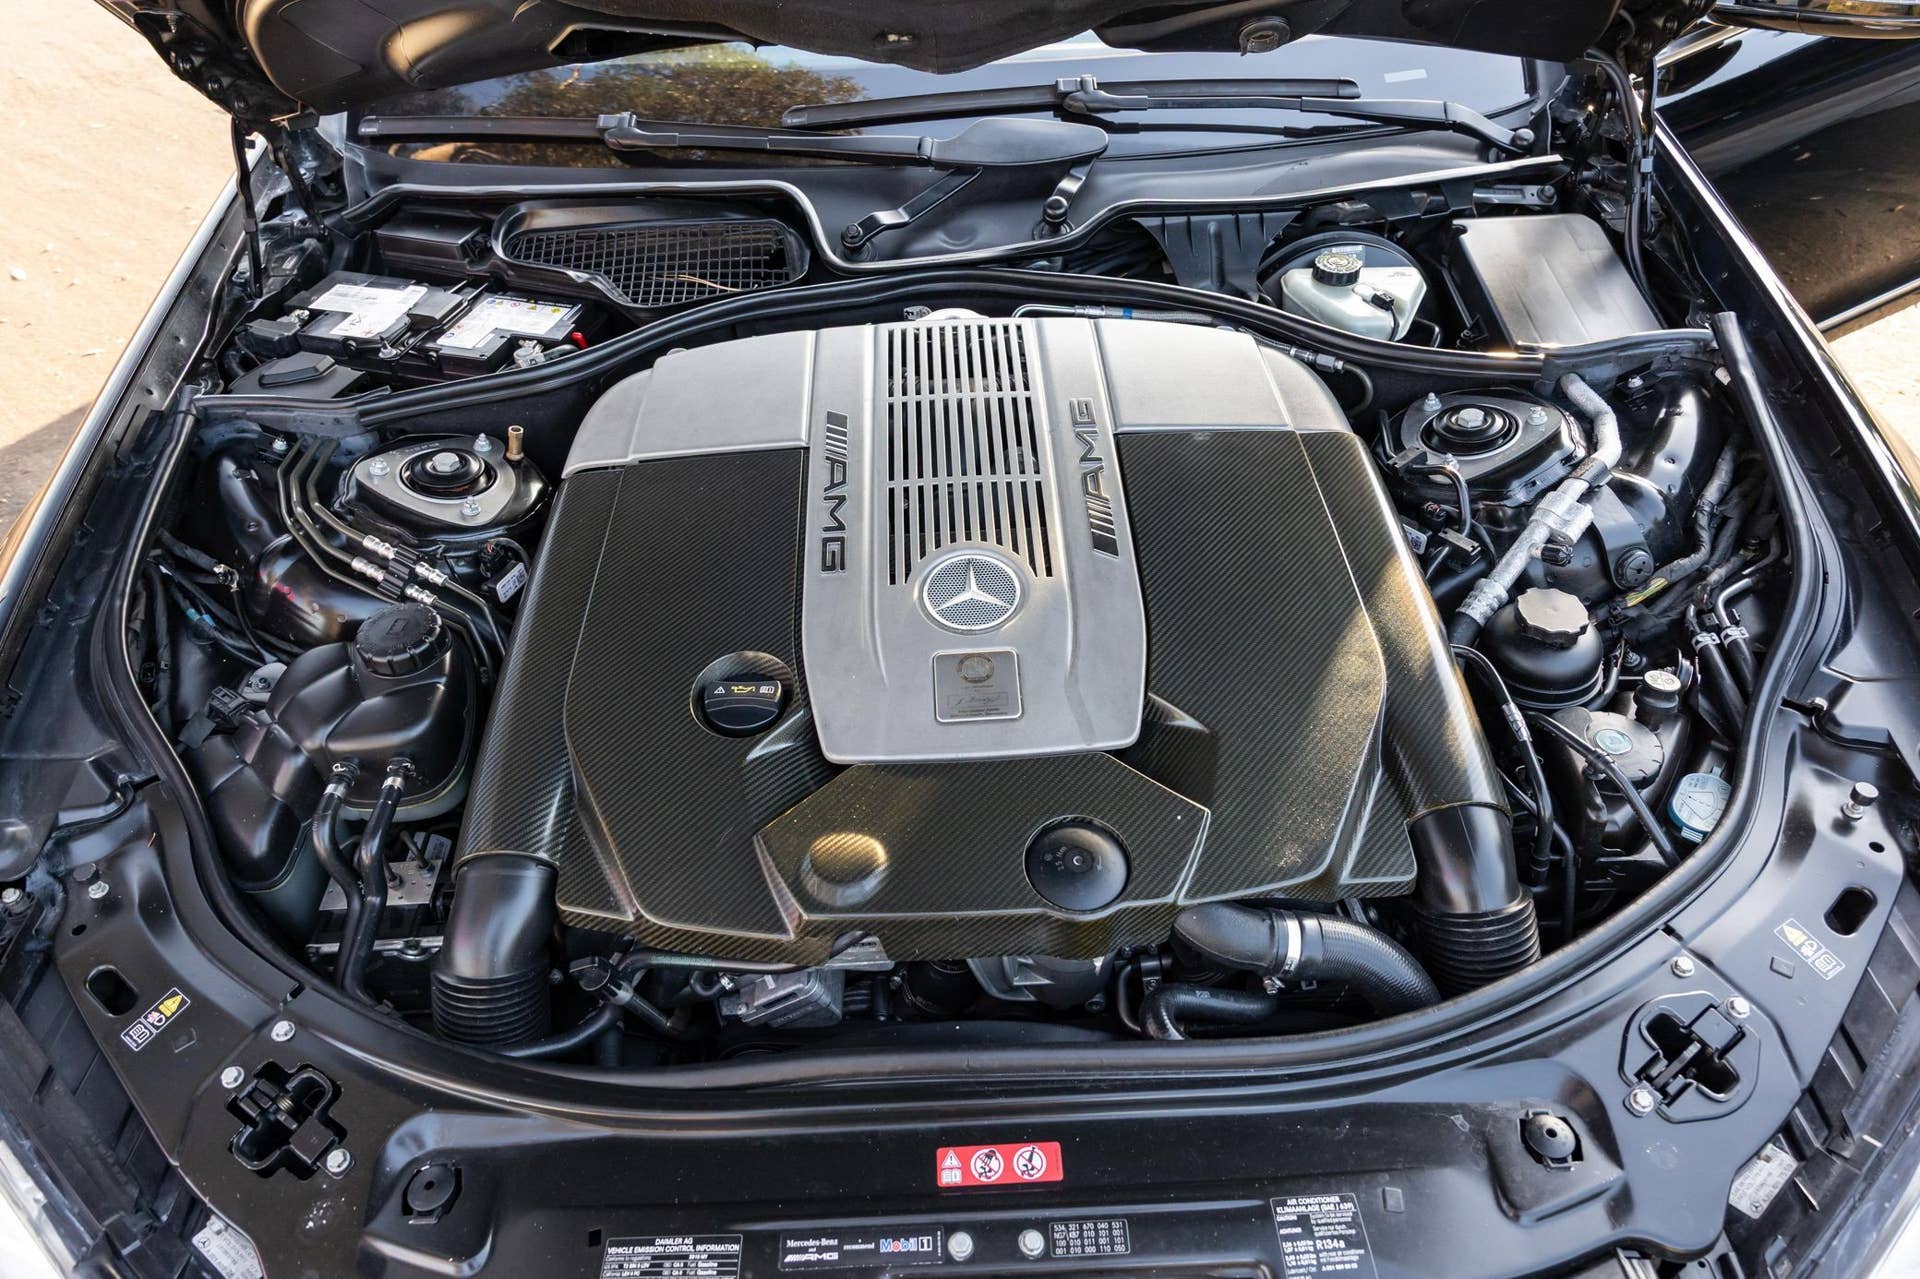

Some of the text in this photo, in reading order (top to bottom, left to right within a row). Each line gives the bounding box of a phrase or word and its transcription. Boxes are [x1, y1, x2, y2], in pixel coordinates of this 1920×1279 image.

[1069, 397, 1111, 502] AMG
[821, 455, 848, 572] AMG
[1298, 1195, 1340, 1205] CONDITIONER
[1111, 1221, 1123, 1229] 531
[1098, 1229, 1109, 1237] 101
[655, 1237, 694, 1246] DAIMLER AG
[786, 1237, 839, 1249] Mercedes-Benz
[879, 1236, 917, 1252] Mobil
[1055, 1239, 1067, 1247] 100
[1084, 1238, 1095, 1246] 011
[1099, 1237, 1110, 1245] 001
[1114, 1236, 1124, 1244] 101
[1316, 1239, 1346, 1250] R134a
[634, 1246, 665, 1254] EMISSION
[665, 1245, 695, 1253] CONTROL
[1055, 1247, 1067, 1255] 001
[1070, 1246, 1082, 1254] 010
[801, 1251, 839, 1261] AMG
